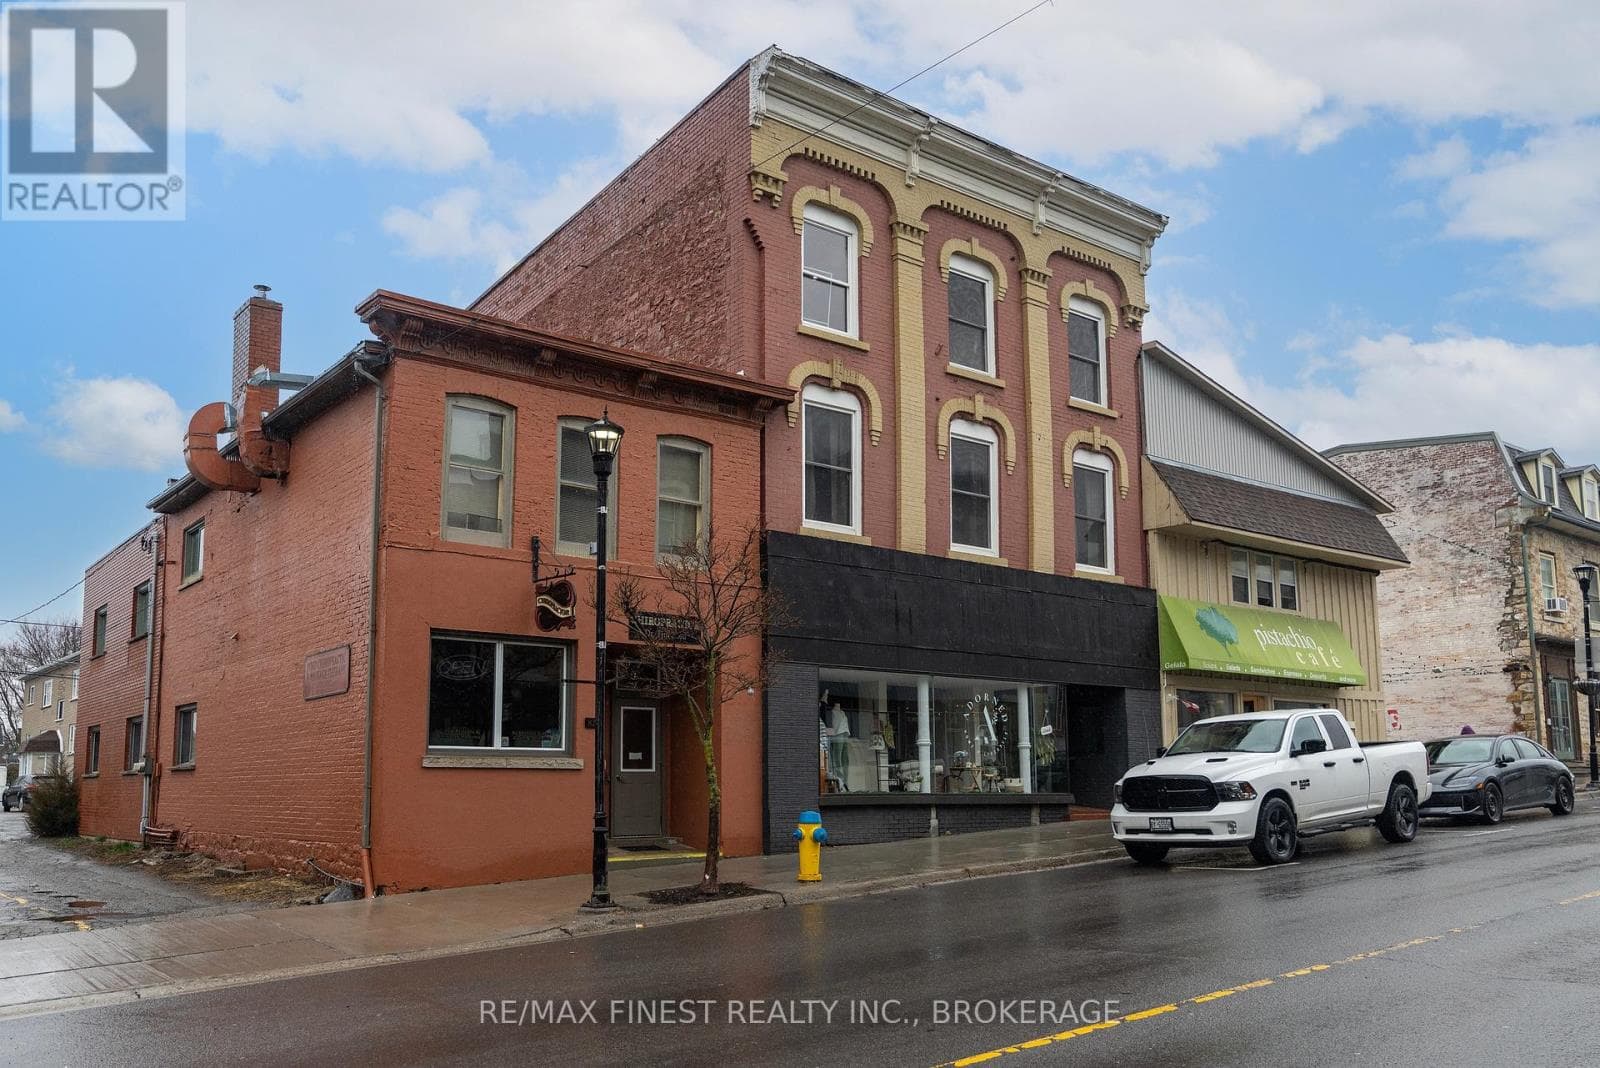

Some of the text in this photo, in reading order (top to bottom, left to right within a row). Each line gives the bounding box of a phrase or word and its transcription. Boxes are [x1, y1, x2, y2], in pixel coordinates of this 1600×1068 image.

[1253, 623, 1318, 651] pistachio
[1164, 660, 1186, 669] Gelato
[1295, 646, 1343, 669] café
[962, 692, 1008, 722] ADORNED
